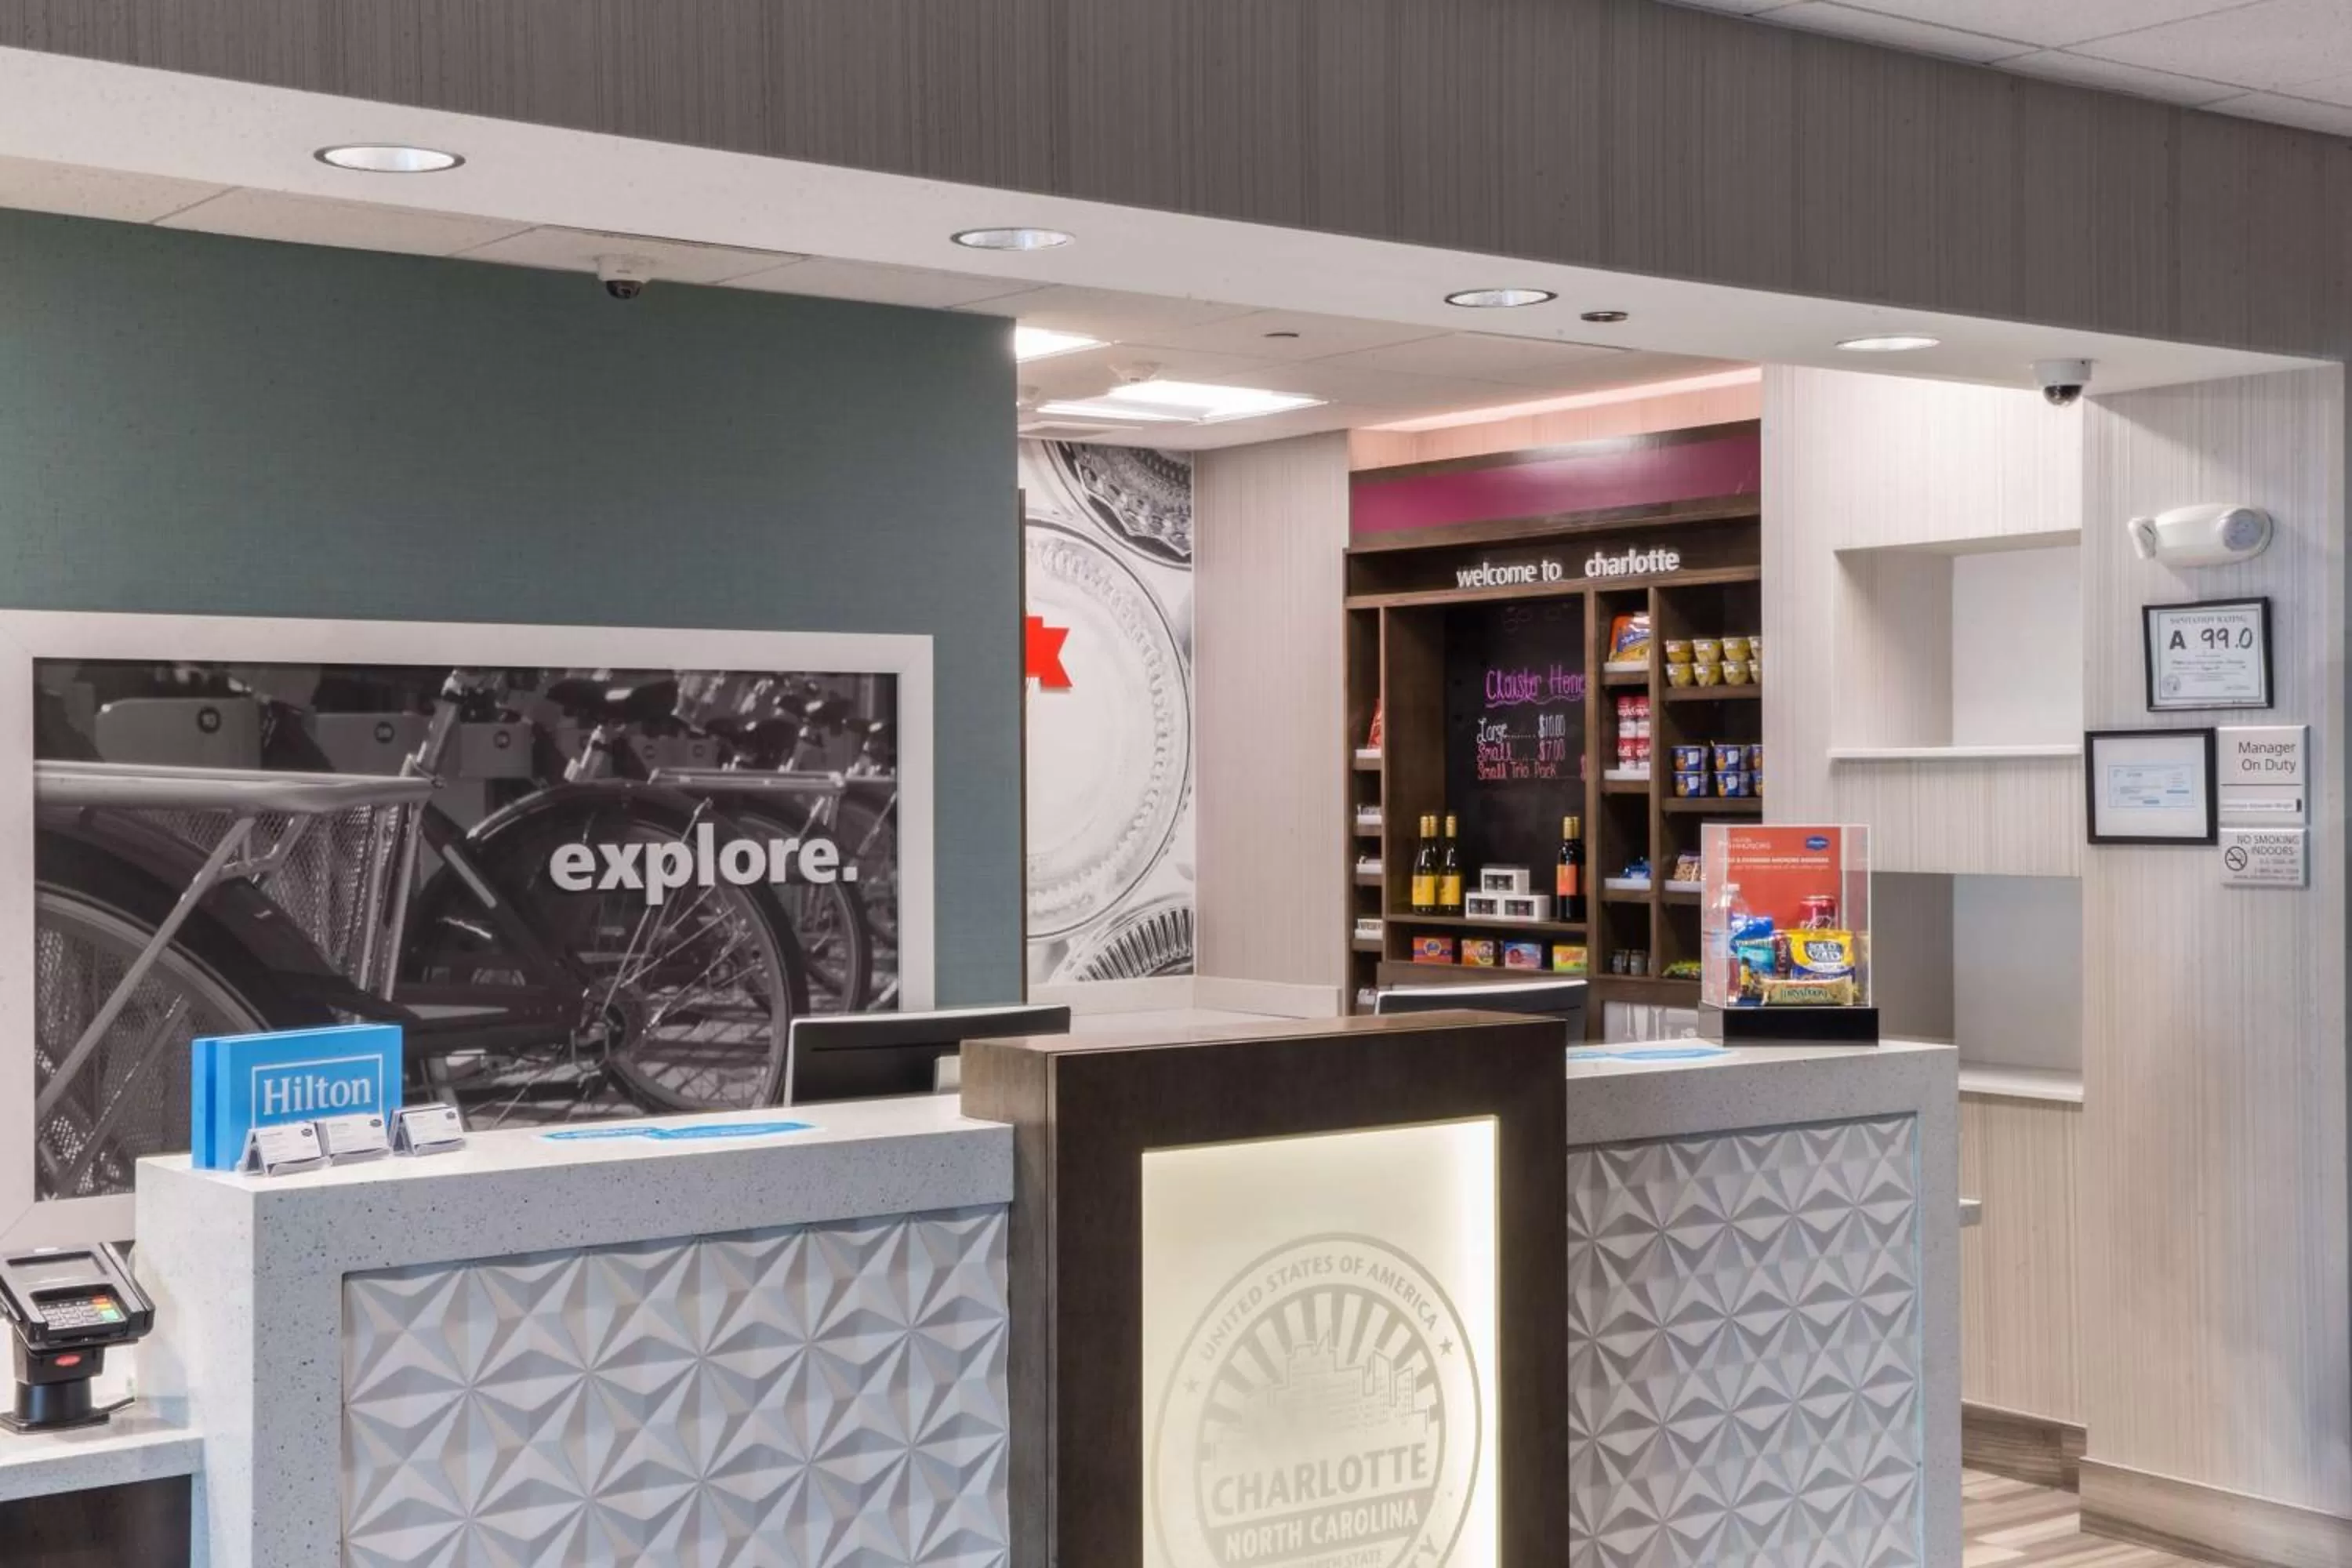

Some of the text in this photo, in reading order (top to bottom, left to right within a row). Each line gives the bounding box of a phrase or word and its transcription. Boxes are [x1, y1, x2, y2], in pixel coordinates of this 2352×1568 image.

[1457, 548, 1680, 588] welcome to charlotte
[2169, 630, 2187, 650] A
[2238, 742, 2296, 757] Manager
[2241, 758, 2296, 773] On Duty
[2237, 834, 2299, 844] NO SMOKING
[549, 822, 858, 906] explore.
[263, 1075, 371, 1115] Hilton
[1200, 1254, 1438, 1360] UNITED STATES OF AMERICA
[1211, 1443, 1428, 1516] CHARLOTTE
[1225, 1499, 1418, 1562] NORTH CAROLINA
